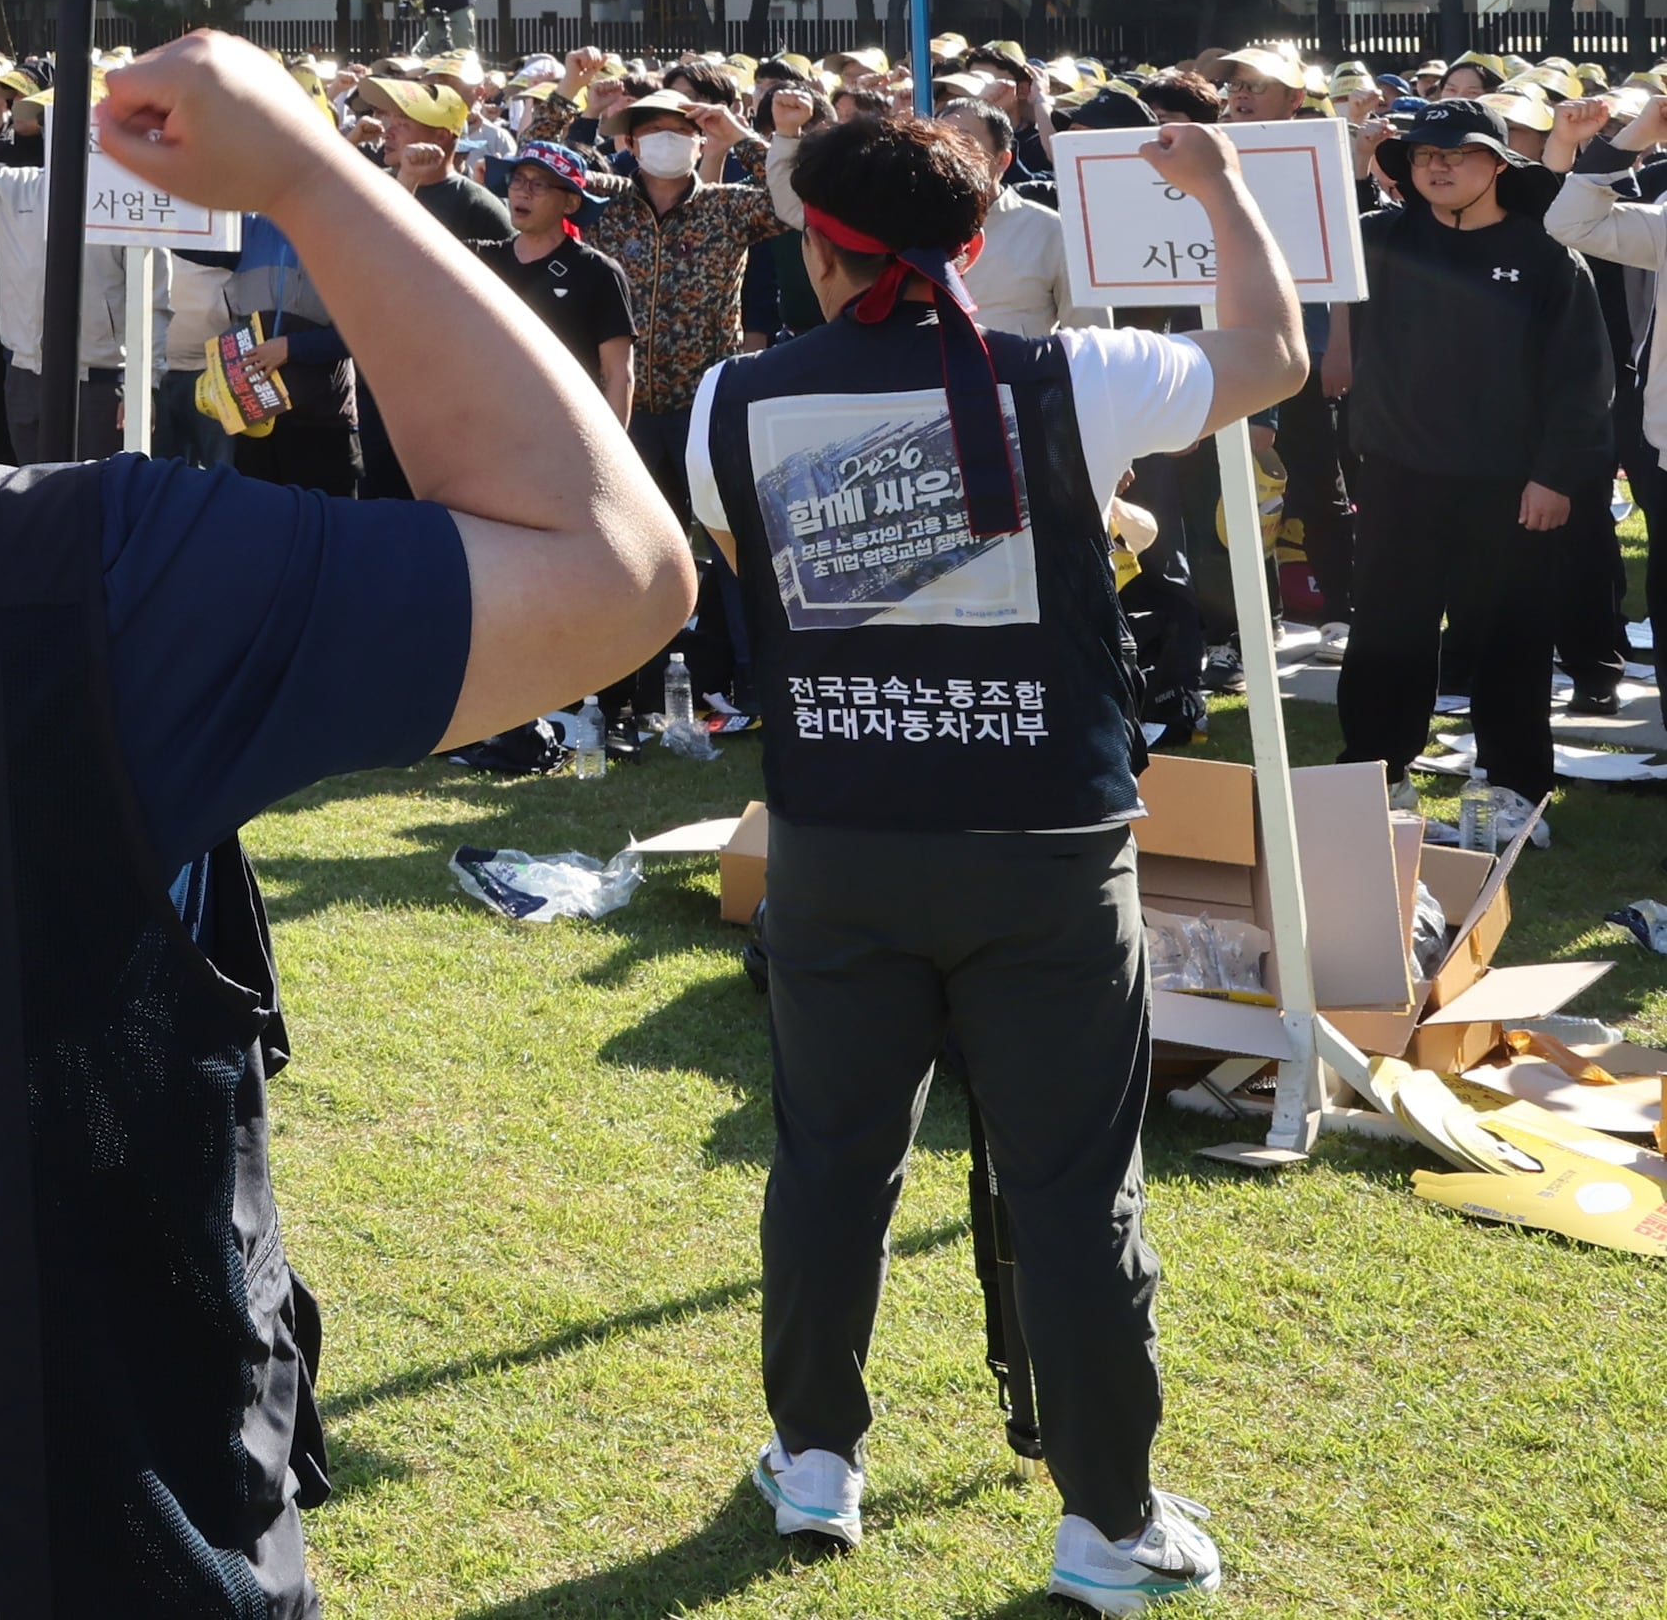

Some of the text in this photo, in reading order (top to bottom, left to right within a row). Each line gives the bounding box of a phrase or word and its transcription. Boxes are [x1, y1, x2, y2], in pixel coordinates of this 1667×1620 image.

[92, 188, 177, 223] 사업부
[838, 436, 923, 495] 2026
[787, 489, 867, 538] 함께
[801, 540, 833, 563] 모든
[835, 526, 903, 554] 노동자의
[907, 516, 943, 539] 고용
[788, 675, 1047, 710] 전국금속노동조합
[793, 706, 1050, 747] 현대자동차지부
